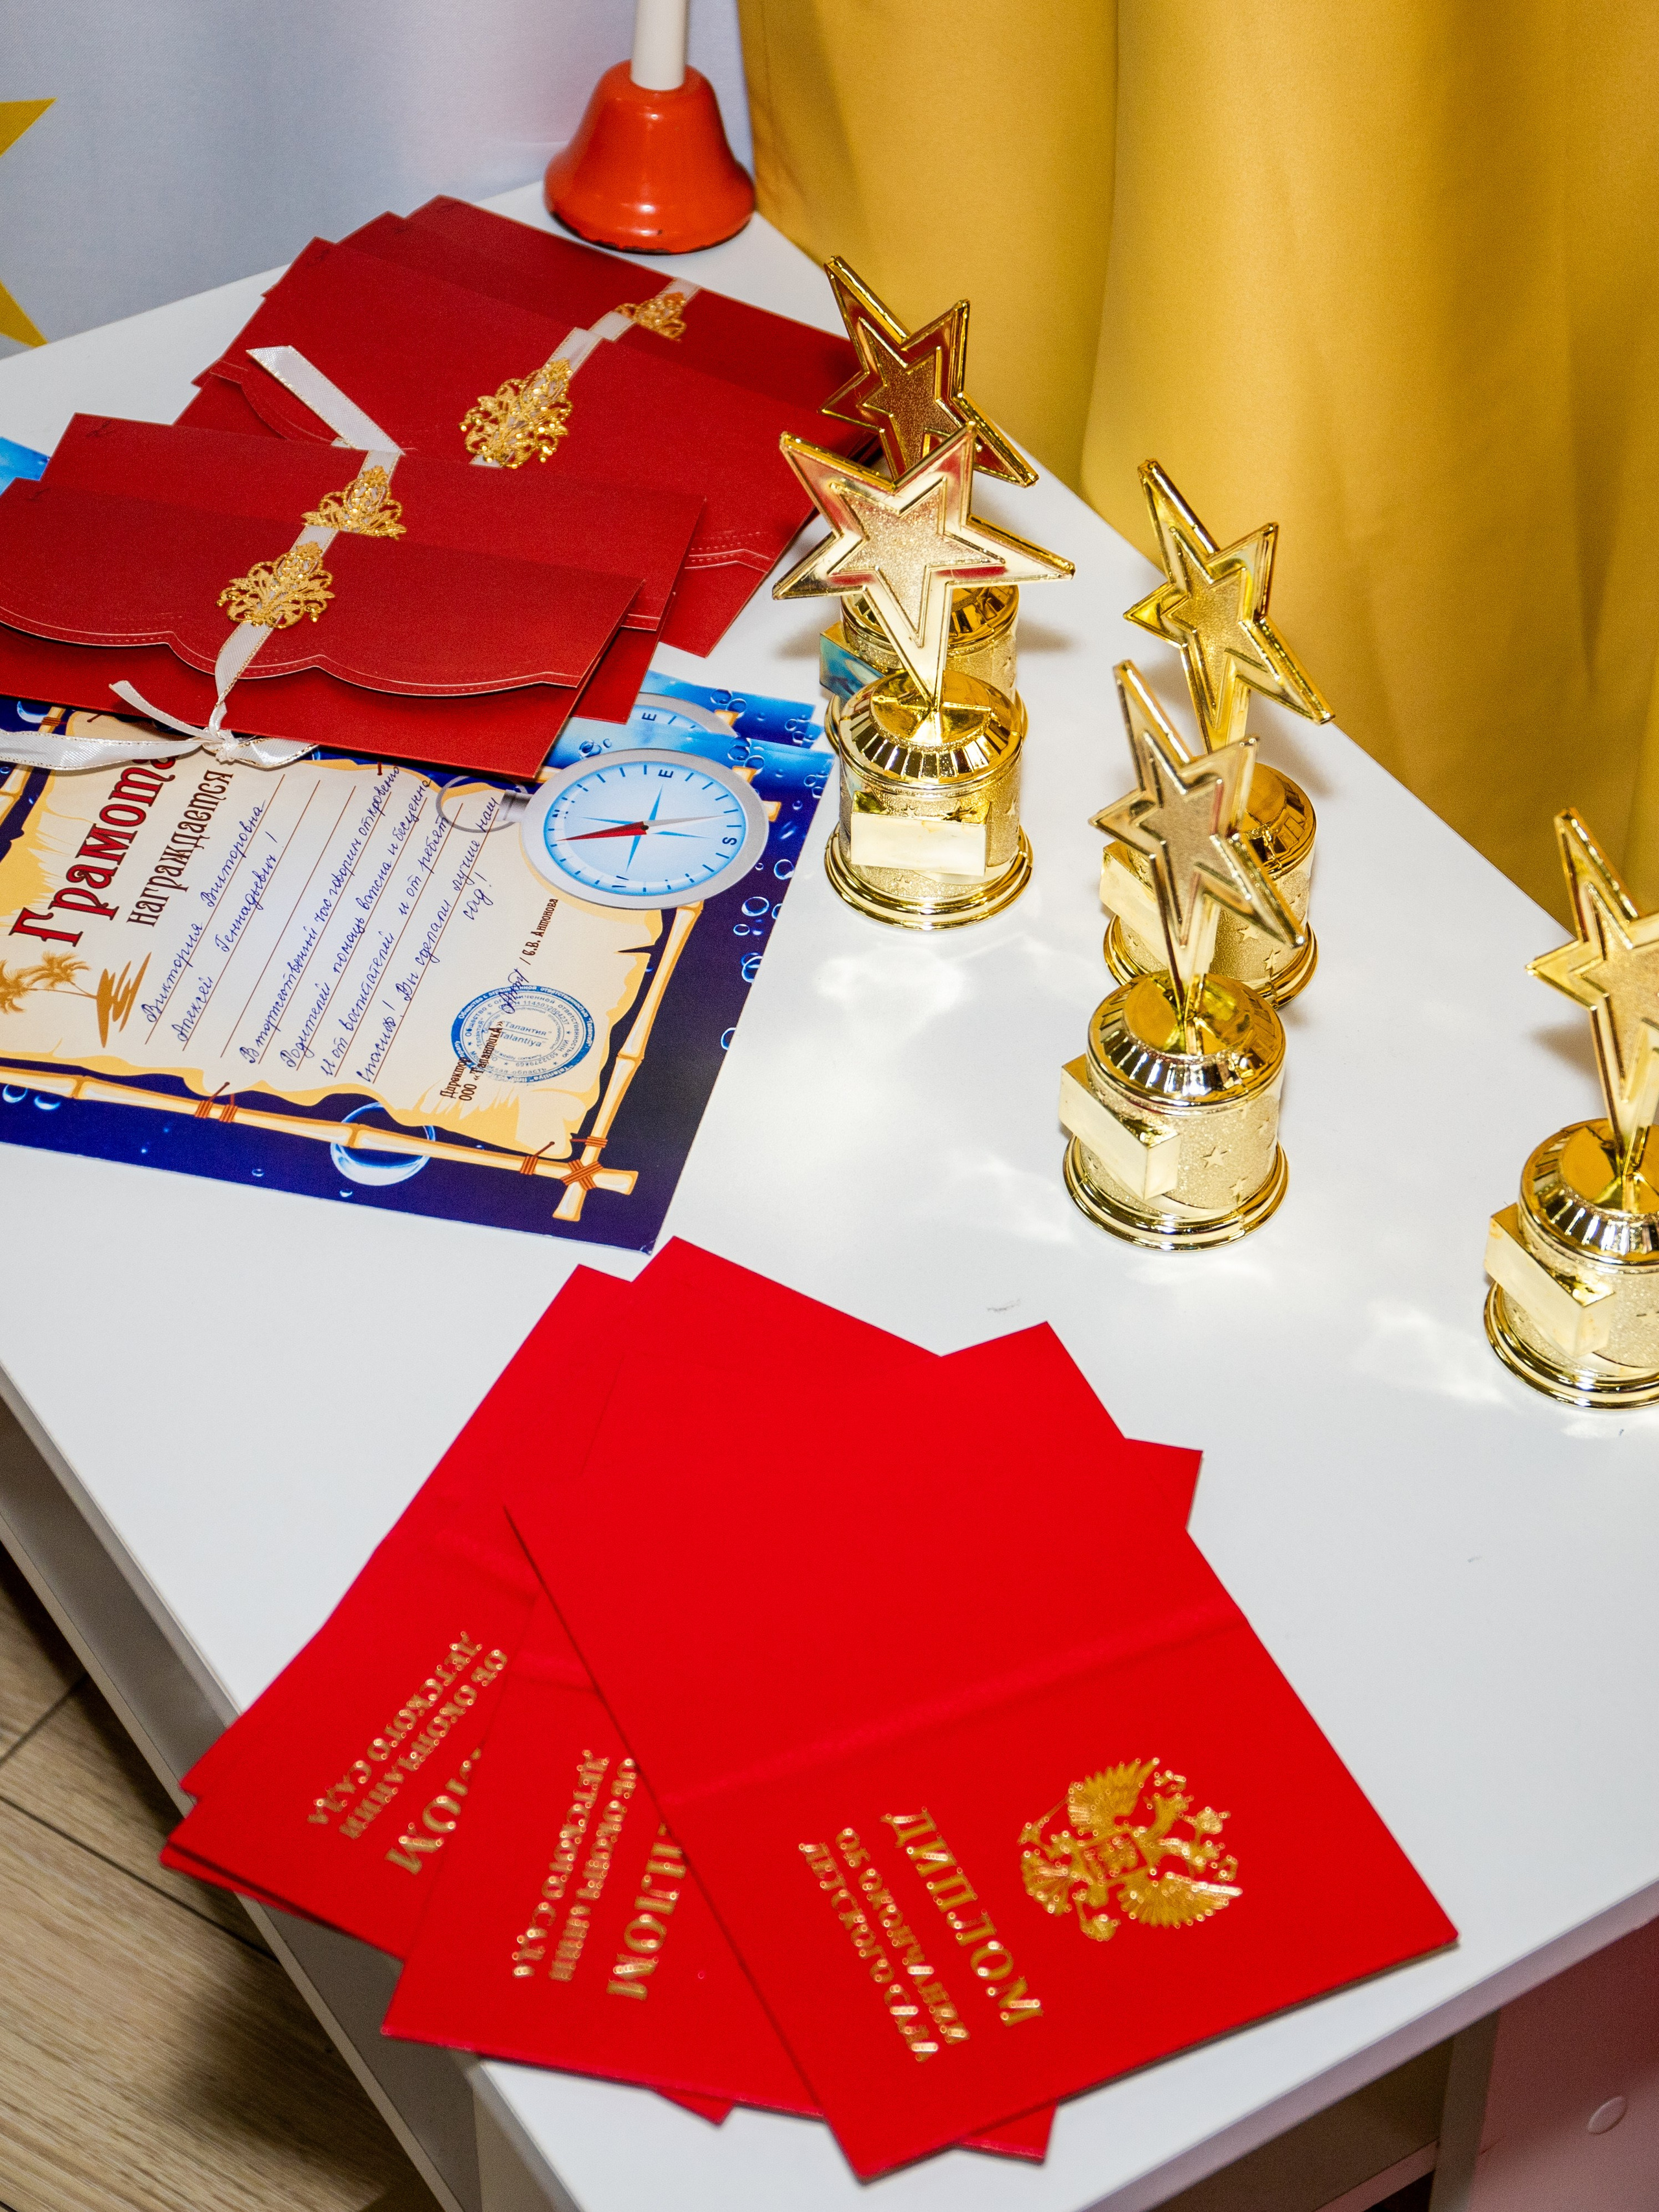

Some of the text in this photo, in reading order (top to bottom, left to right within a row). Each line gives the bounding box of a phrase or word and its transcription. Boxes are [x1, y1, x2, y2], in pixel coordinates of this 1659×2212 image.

[126, 769, 234, 927] награждается
[141, 800, 266, 1023] Виктория Викторовна
[531, 898, 559, 938] Антонова
[171, 977, 213, 1042] Алексей
[440, 1056, 472, 1099] Директор
[606, 1821, 687, 2001] ПЛОМ
[798, 1841, 940, 2063] ДЕТСКОГО САДА
[835, 1826, 971, 2045] ОБ ОКОНЧАНИИ
[879, 1806, 1044, 2027] ДИПЛОМ
